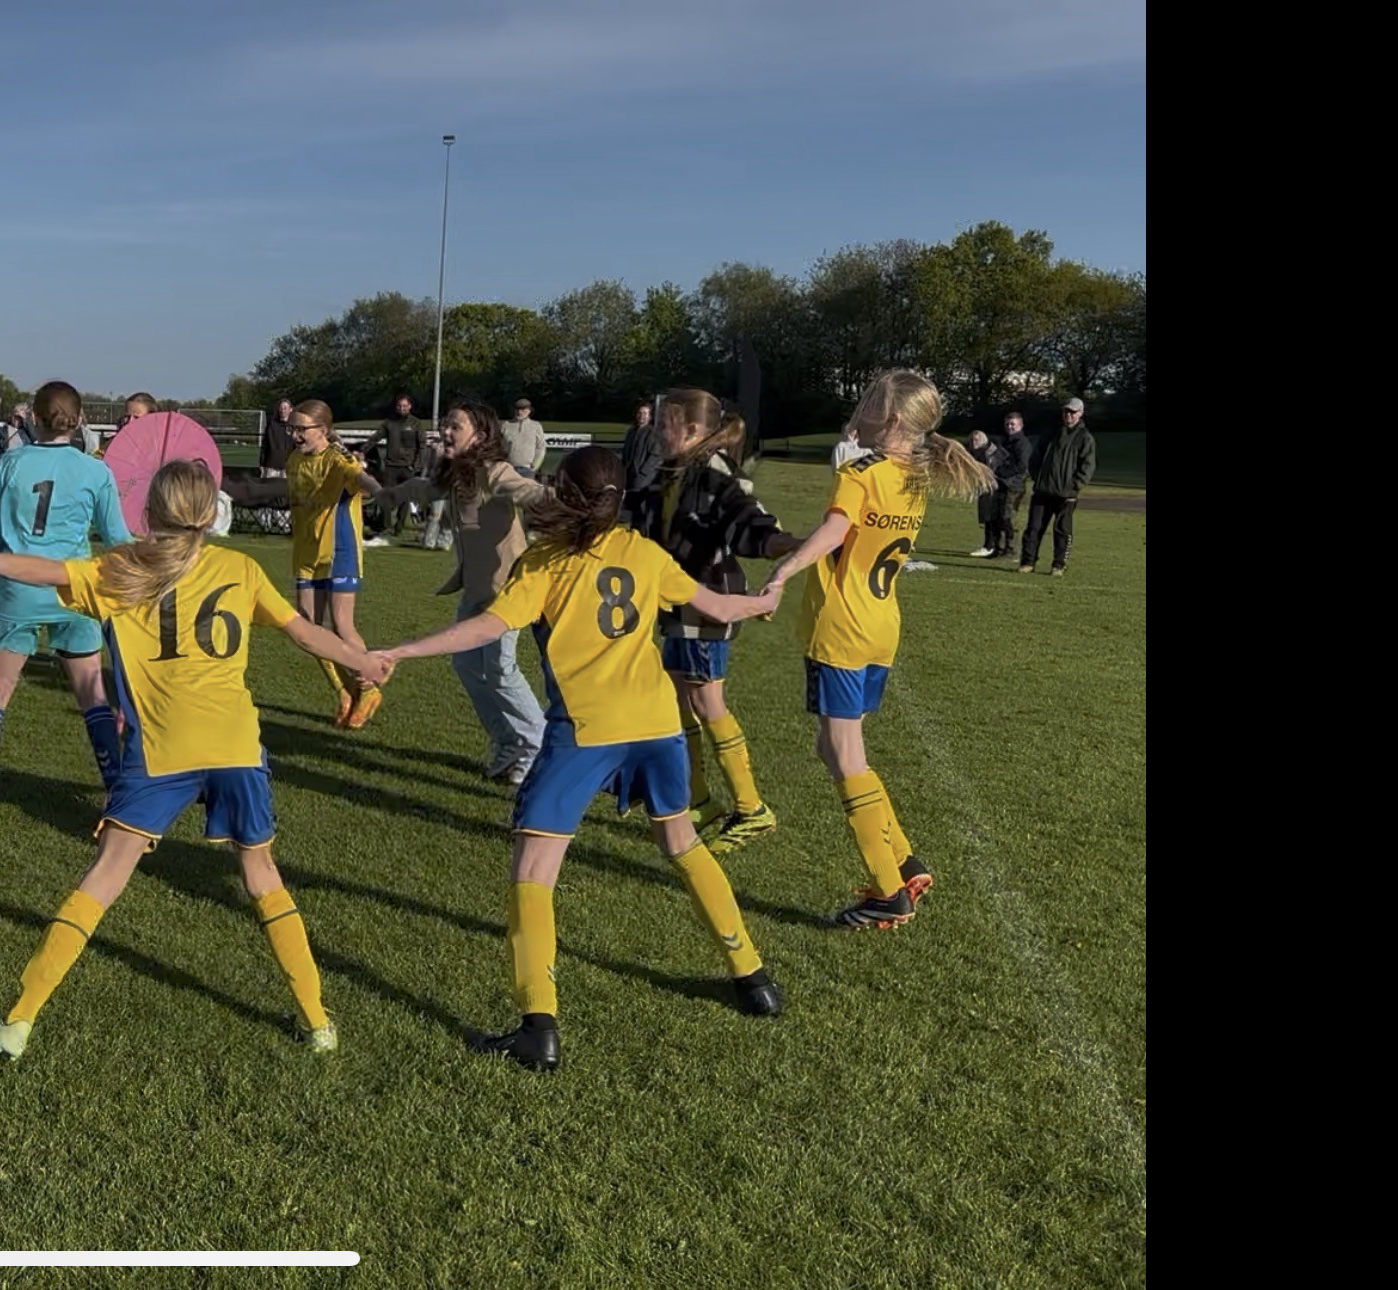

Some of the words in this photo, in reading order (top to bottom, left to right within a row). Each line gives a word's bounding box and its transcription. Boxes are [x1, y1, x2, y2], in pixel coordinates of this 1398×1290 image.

[32, 480, 54, 537] 1
[596, 566, 640, 639] 8
[868, 537, 911, 600] 6
[148, 583, 242, 661] 16
